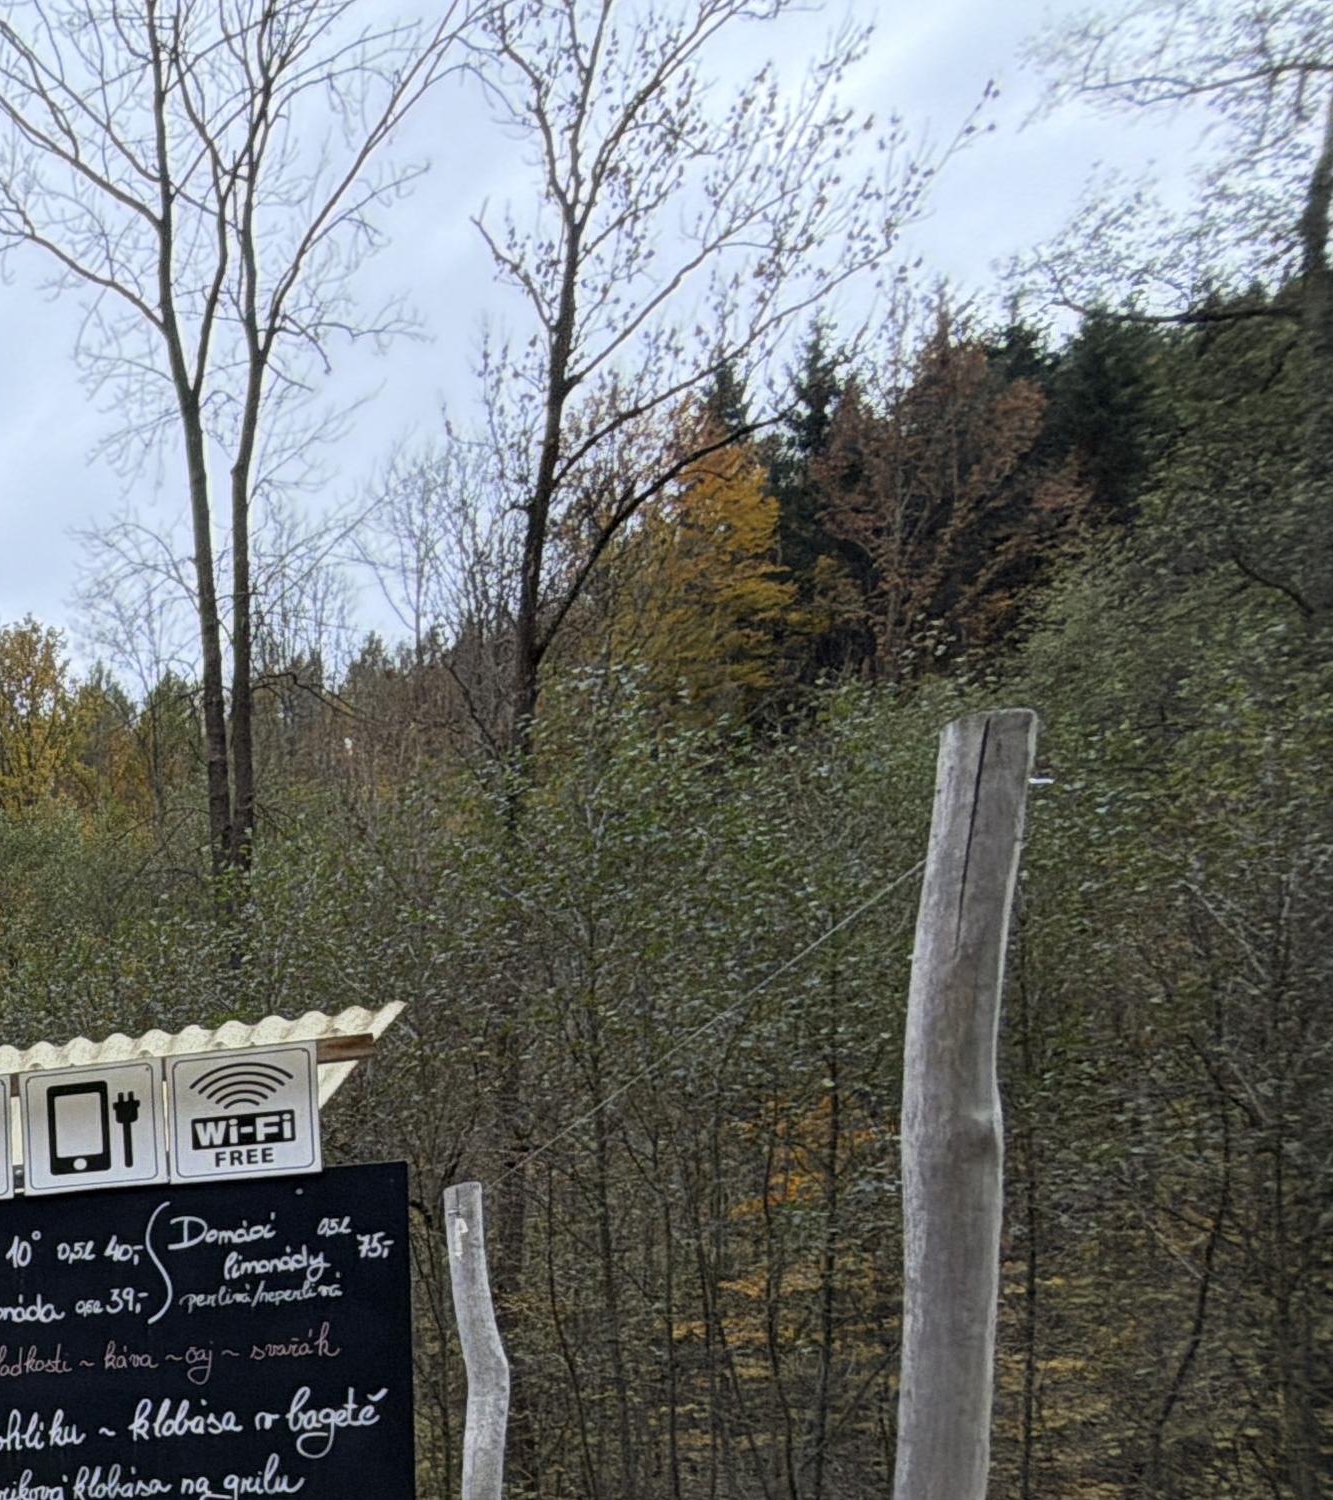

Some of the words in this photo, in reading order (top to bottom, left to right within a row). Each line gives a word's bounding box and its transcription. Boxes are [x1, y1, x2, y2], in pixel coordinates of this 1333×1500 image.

[193, 1113, 296, 1148] Wi-Fi
[214, 1147, 275, 1167] FREE
[6, 1230, 41, 1268] 10°
[167, 1211, 276, 1250] Domácí
[224, 1244, 331, 1282] limonády
[103, 1340, 160, 1369] káva
[250, 1321, 341, 1360] svařák
[128, 1397, 243, 1441] klobása
[285, 1385, 389, 1459] bagetě
[180, 1475, 211, 1495] na
